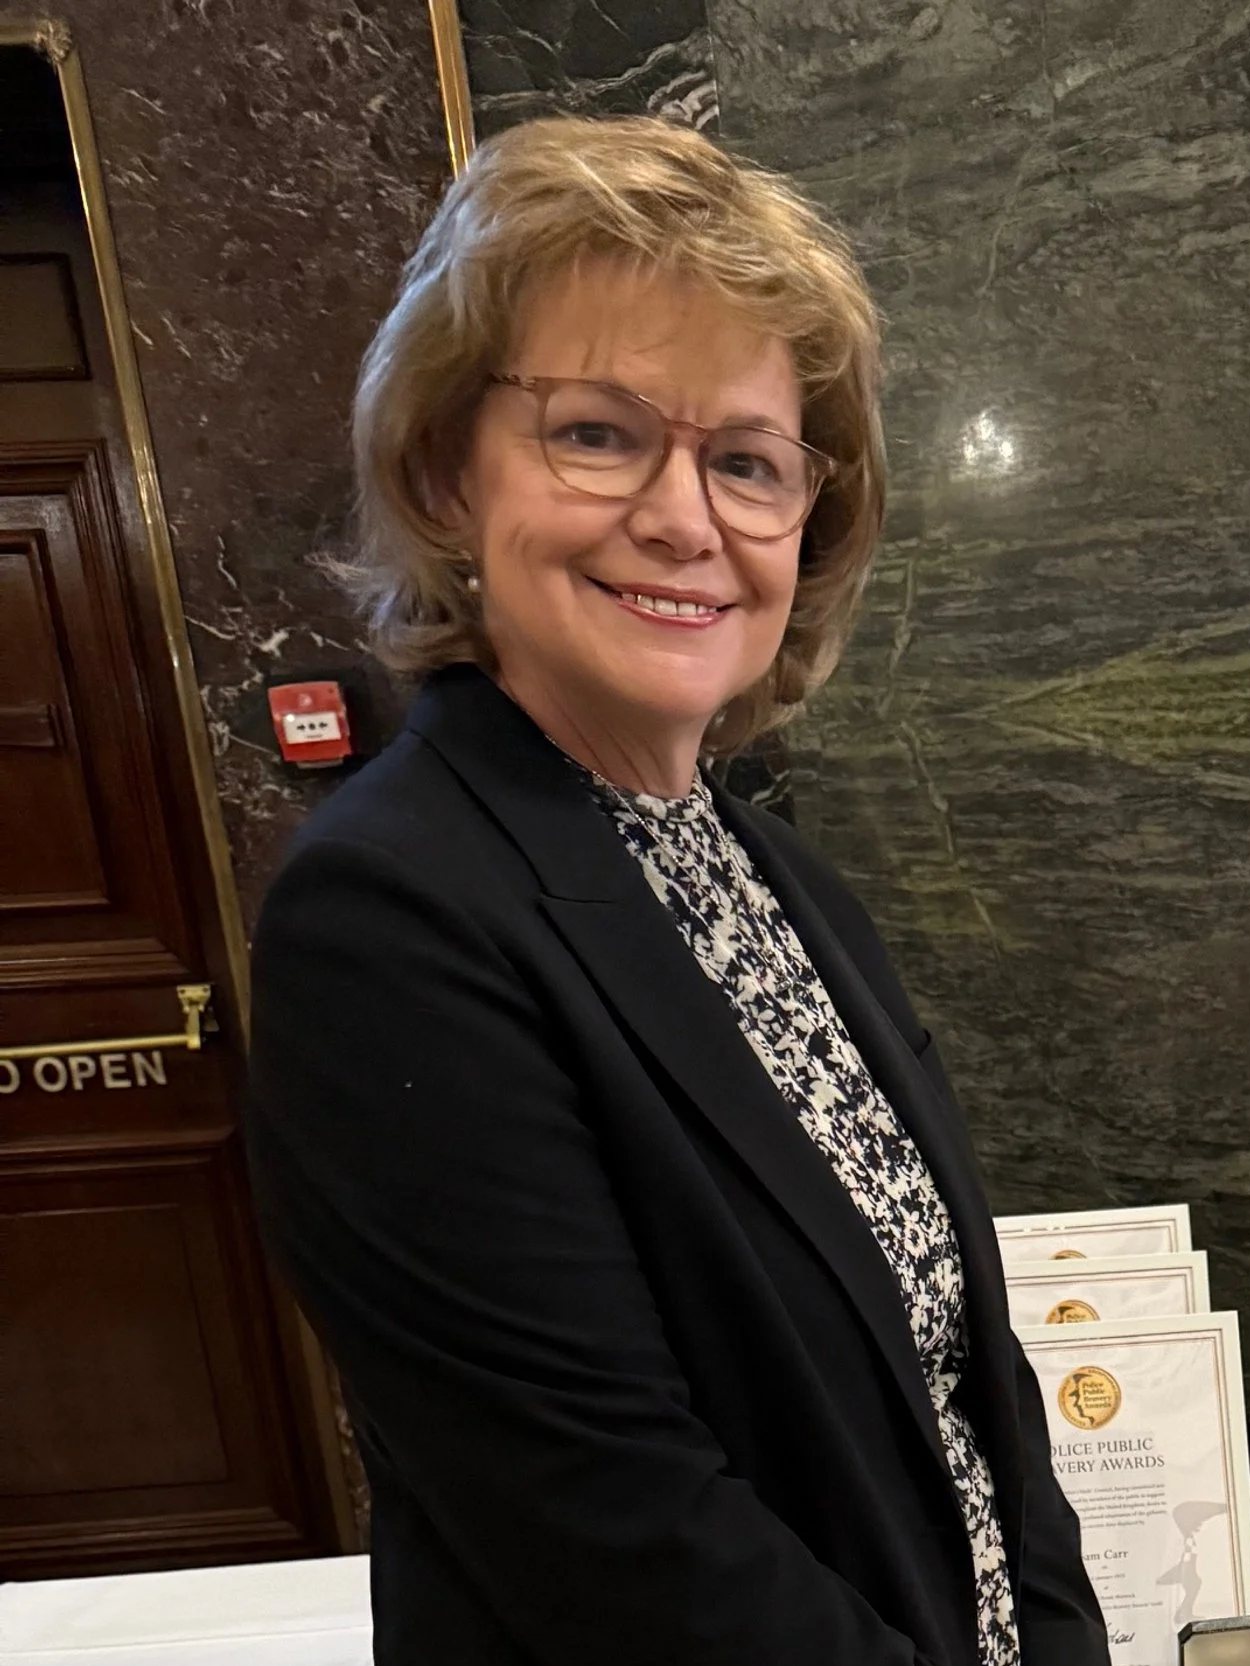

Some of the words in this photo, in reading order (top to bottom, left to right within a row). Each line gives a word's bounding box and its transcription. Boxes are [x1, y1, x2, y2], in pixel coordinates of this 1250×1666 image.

[33, 1051, 167, 1093] OPEN
[1051, 1442, 1093, 1457] OLICE
[1098, 1438, 1153, 1454] PUBLIC
[1100, 1455, 1165, 1471] AWARDS
[1103, 1549, 1129, 1560] Carr
